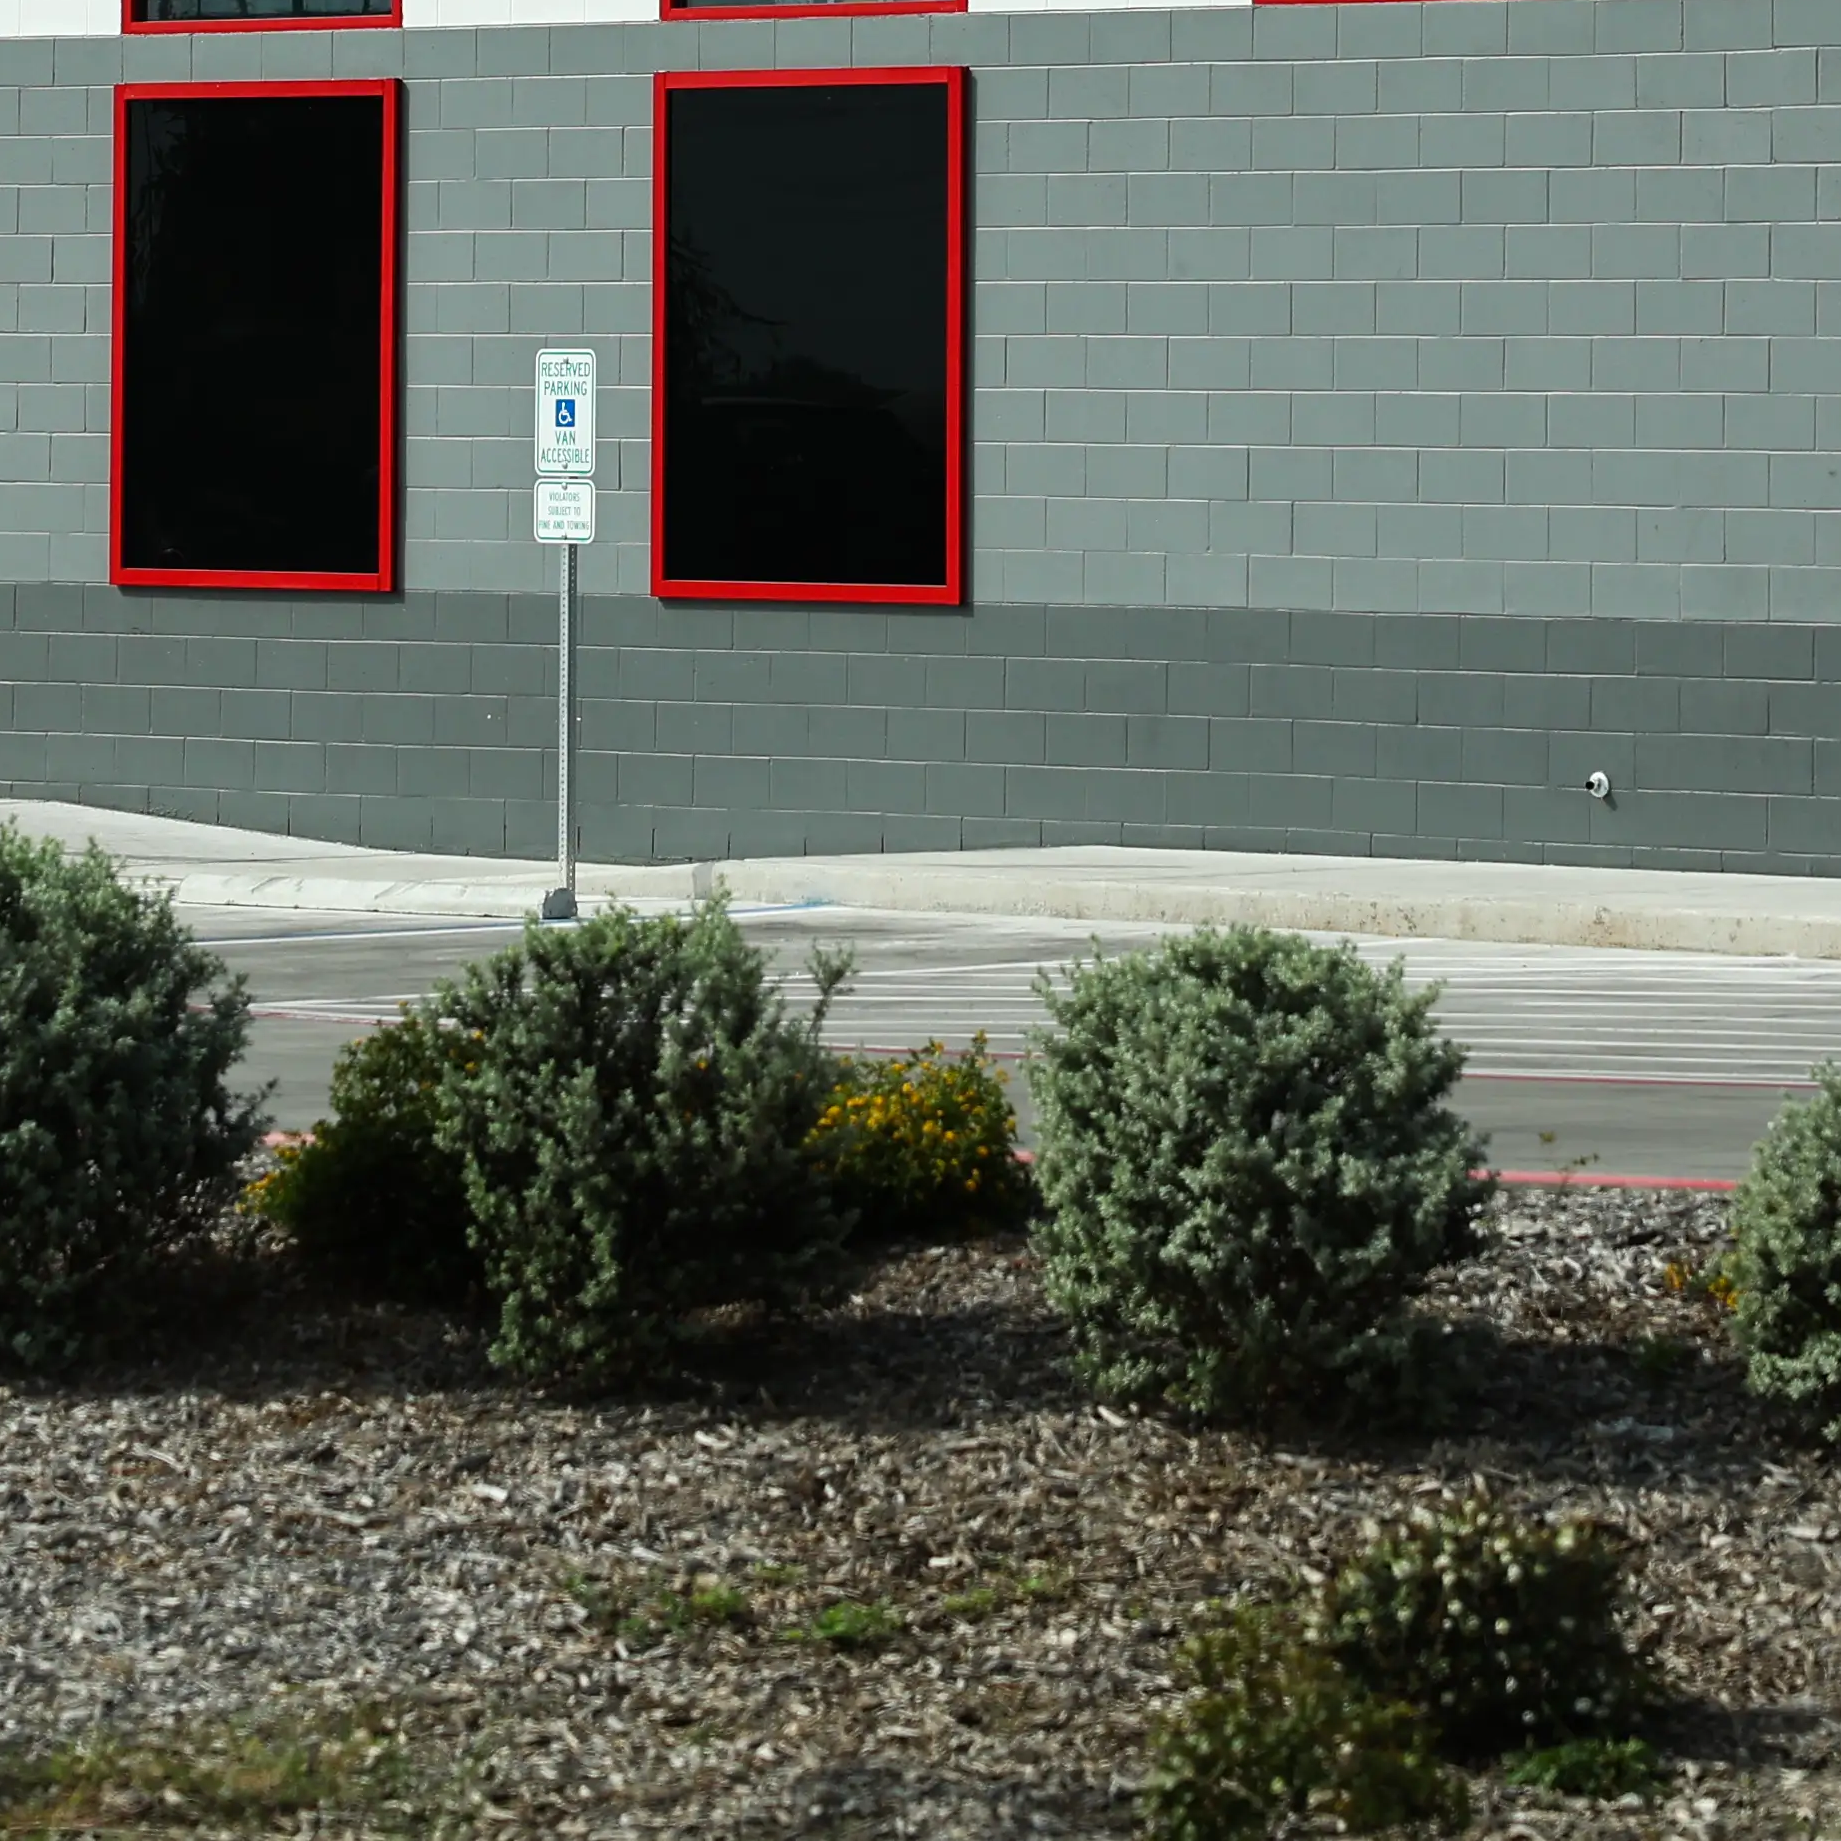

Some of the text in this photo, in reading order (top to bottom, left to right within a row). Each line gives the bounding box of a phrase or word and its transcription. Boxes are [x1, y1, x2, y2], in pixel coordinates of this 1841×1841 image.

[541, 362, 591, 377] RESERVED
[544, 381, 587, 396] PARKING
[555, 430, 576, 445] VAN
[541, 448, 590, 464] ACCESSIBLE
[549, 492, 580, 502] VIOLATORS
[548, 506, 581, 516] SUBJECT TO
[539, 520, 589, 531] FINE AND TOWING
